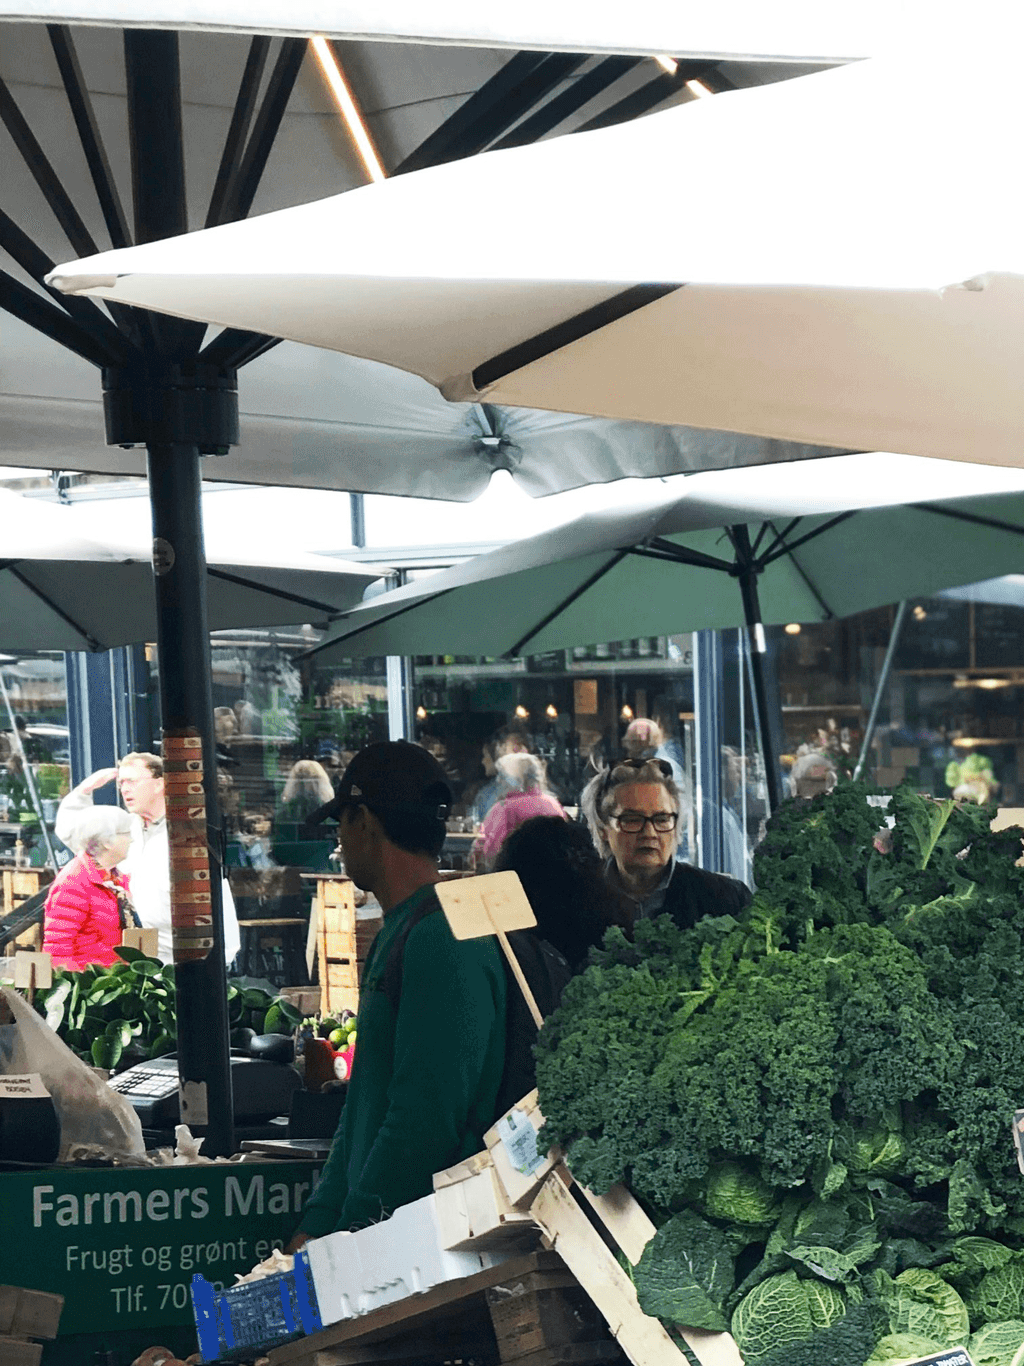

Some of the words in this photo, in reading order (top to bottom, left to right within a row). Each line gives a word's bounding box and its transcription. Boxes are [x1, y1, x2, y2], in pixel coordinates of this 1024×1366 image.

[33, 1185, 209, 1228] Farmers
[66, 1244, 133, 1275] Frugt
[141, 1248, 172, 1272] og
[179, 1238, 248, 1270] grønt
[110, 1284, 148, 1313] Tlf.
